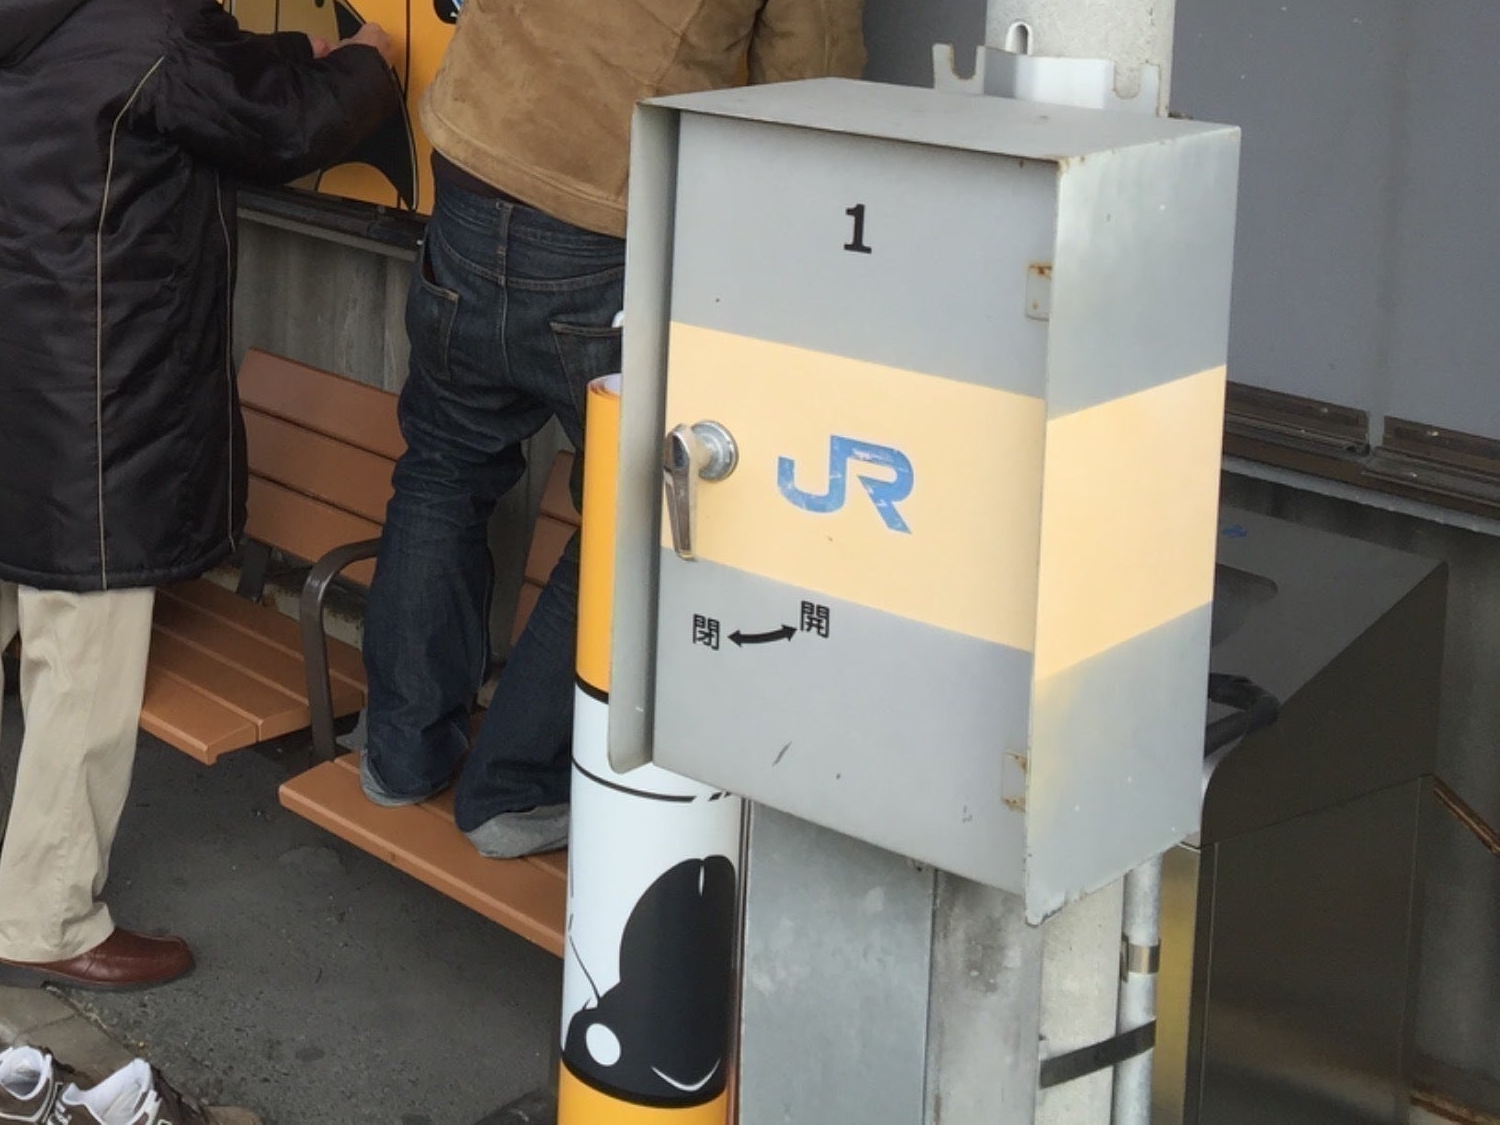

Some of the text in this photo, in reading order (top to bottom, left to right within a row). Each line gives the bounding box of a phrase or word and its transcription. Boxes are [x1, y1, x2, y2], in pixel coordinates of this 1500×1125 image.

[843, 203, 872, 254] 1
[777, 434, 914, 534] JR
[692, 600, 830, 651] 閉 開
